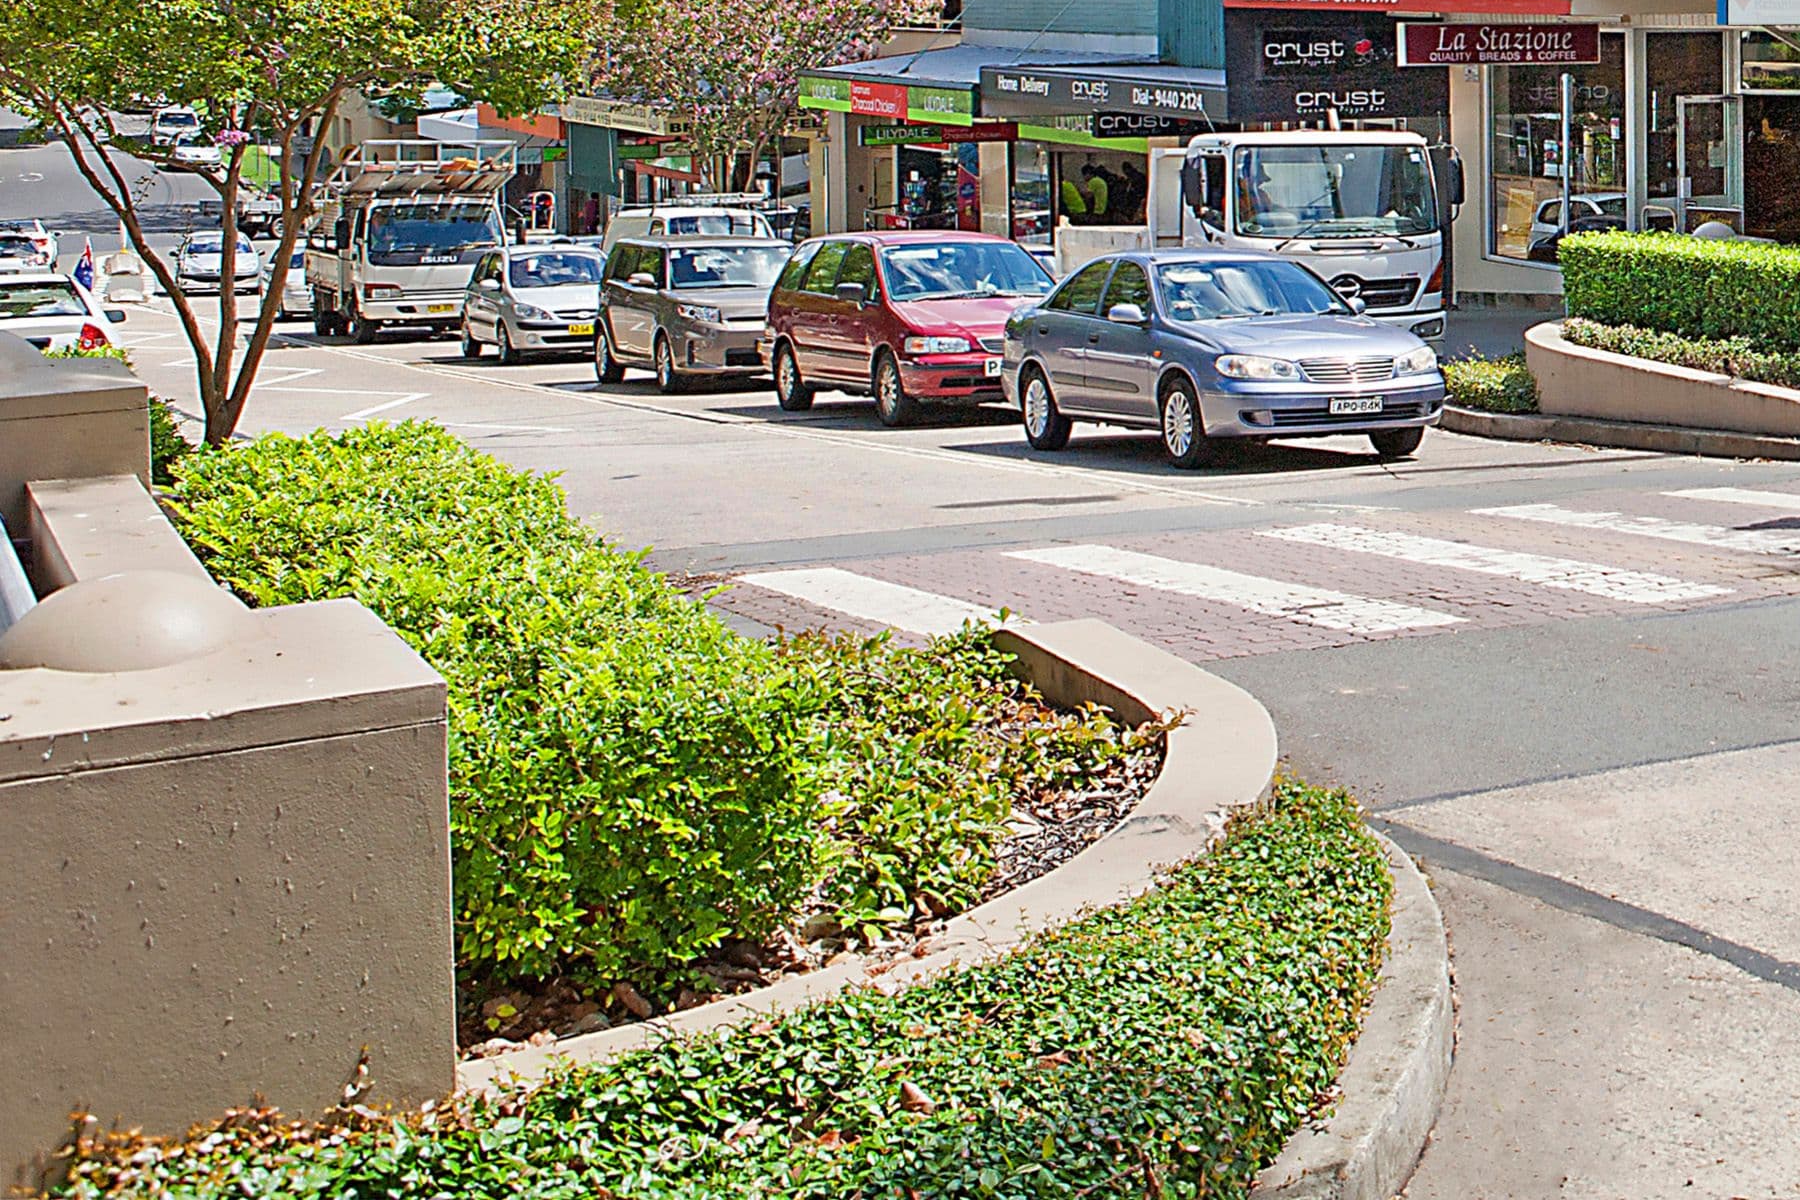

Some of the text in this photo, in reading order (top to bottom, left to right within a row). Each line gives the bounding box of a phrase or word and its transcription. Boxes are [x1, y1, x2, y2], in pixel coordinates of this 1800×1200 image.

[1436, 26, 1573, 51] La Stazione
[1265, 40, 1345, 58] crust
[1429, 50, 1577, 62] QUALITY BREADS & COFFEE
[997, 74, 1050, 97] Home Delivery
[1071, 80, 1109, 97] crust
[1155, 89, 1179, 108] 9440
[1180, 91, 1203, 111] 2124
[1295, 89, 1386, 107] crust
[1099, 114, 1171, 129] crust
[876, 127, 929, 140] LILYDALE
[420, 255, 458, 263] ISUZU
